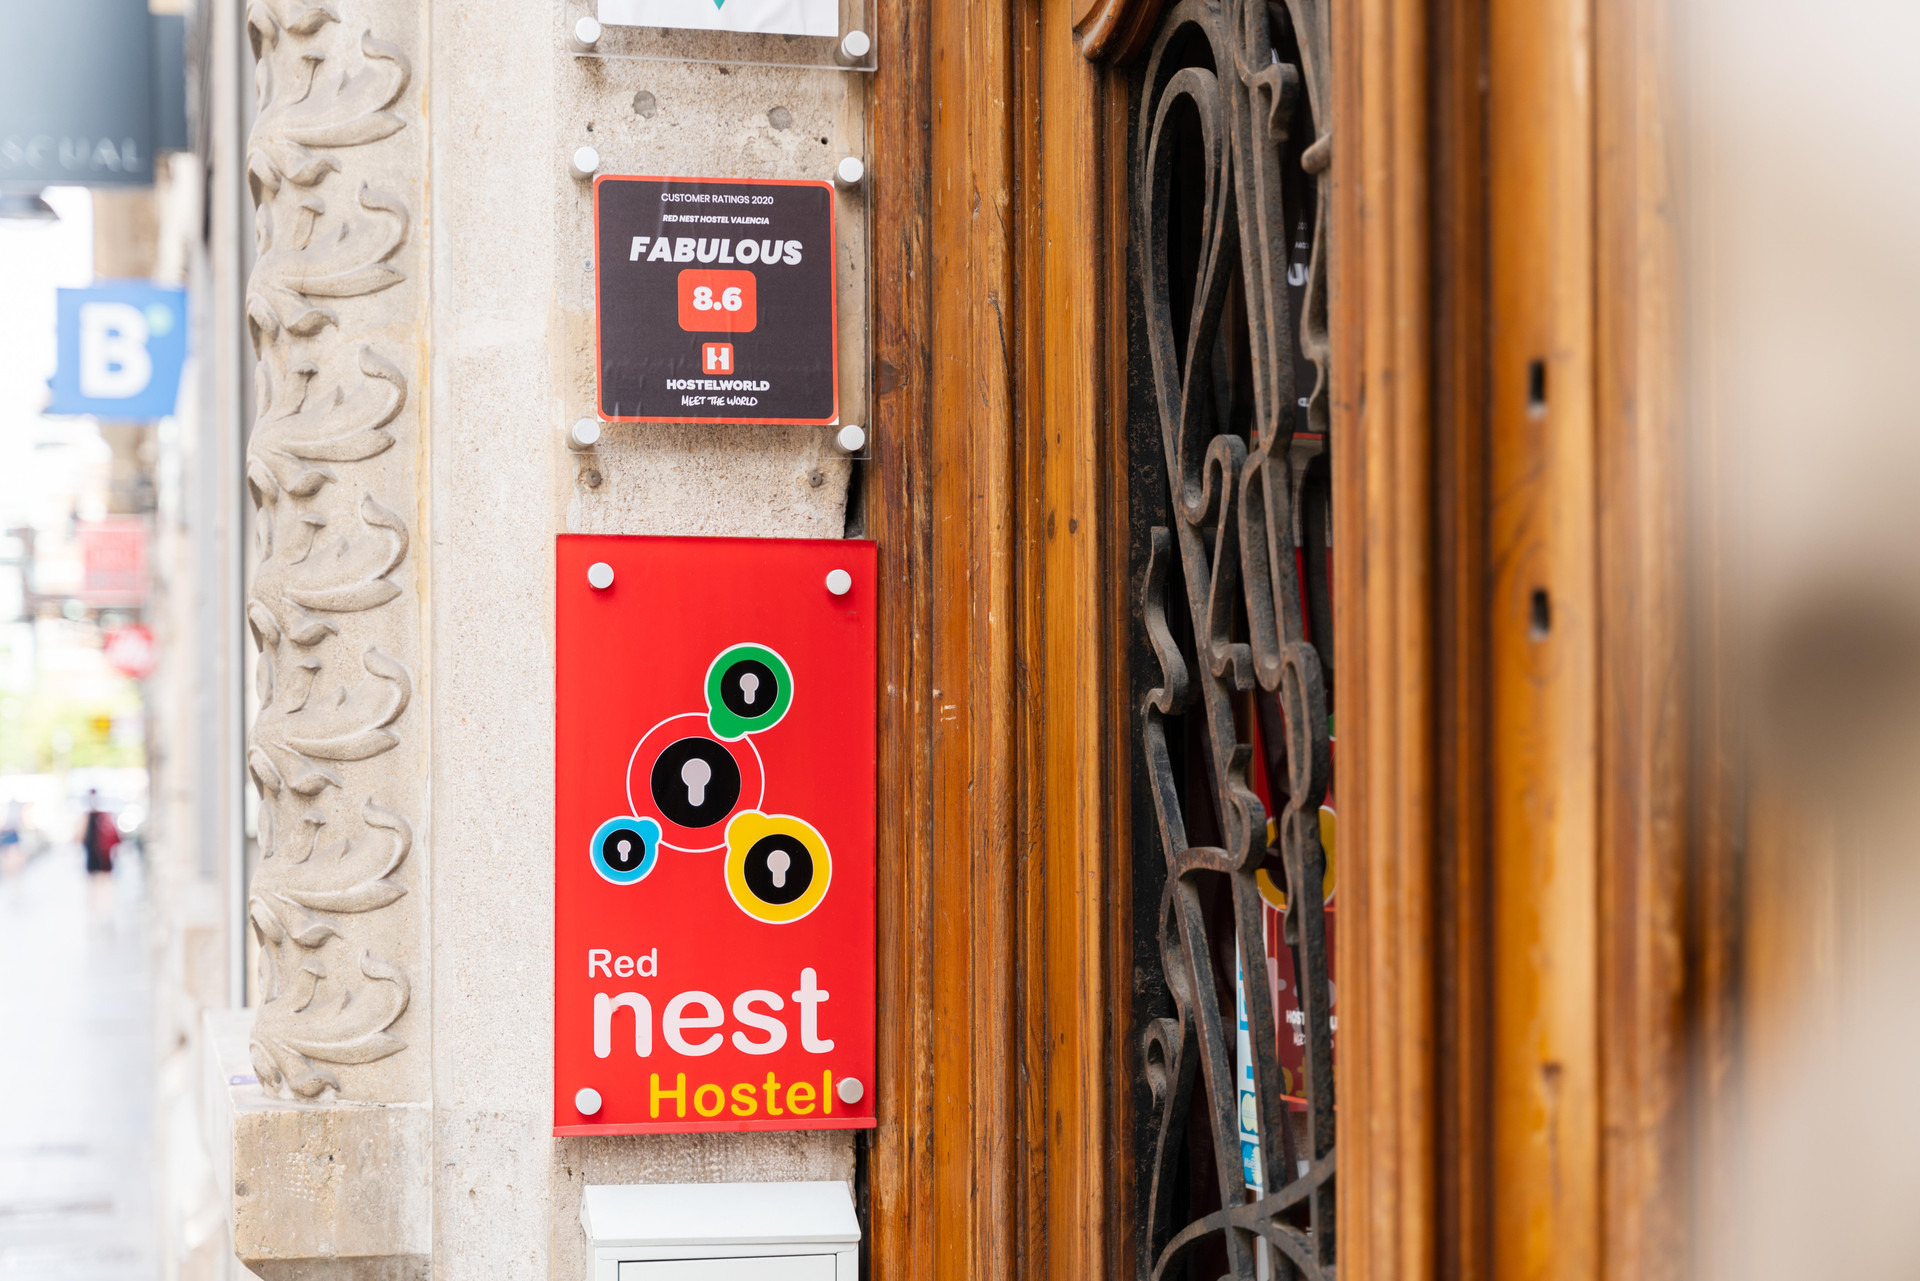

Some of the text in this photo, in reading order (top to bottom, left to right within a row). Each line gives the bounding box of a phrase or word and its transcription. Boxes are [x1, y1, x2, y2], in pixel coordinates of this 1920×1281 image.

[660, 193, 774, 205] CUSTOMER RATINGS 2020
[663, 214, 770, 225] RED NEST HOSTEL VALENCIA
[629, 236, 803, 266] FABULOUS
[692, 286, 743, 312] 8.6
[80, 302, 152, 399] B
[706, 347, 730, 370] H
[666, 379, 770, 392] HOSTELWORLD
[681, 395, 758, 407] MEET THE WORLD
[588, 947, 658, 978] Red
[593, 966, 835, 1059] nest
[649, 1069, 832, 1119] Hostel
